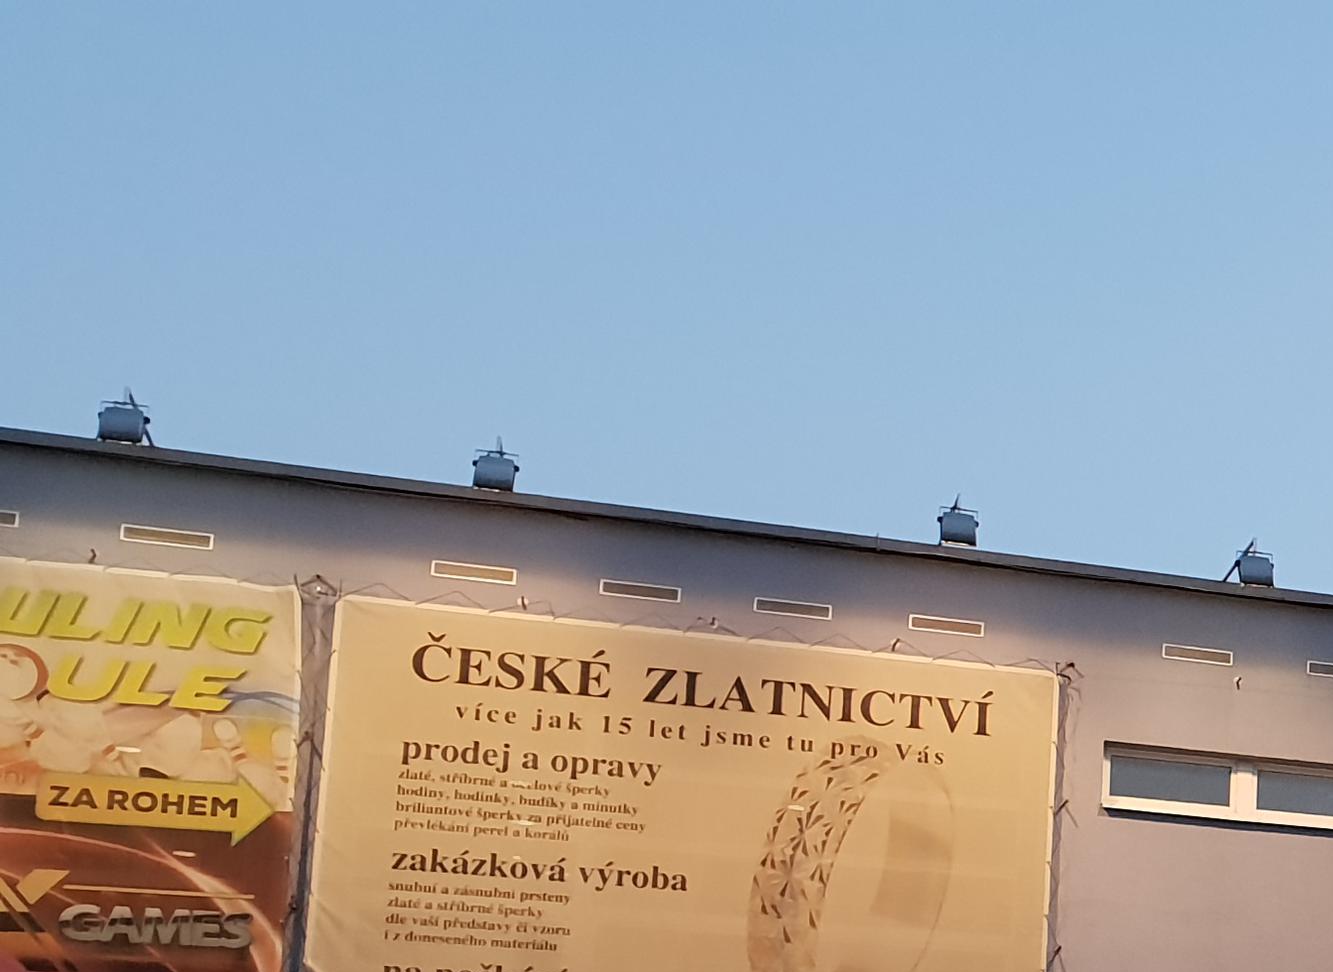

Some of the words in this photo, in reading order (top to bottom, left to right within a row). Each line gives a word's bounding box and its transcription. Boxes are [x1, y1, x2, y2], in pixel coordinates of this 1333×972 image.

[412, 631, 611, 699] ČESKÉ
[642, 667, 995, 737] ZLATNICTVÍ
[455, 702, 517, 725] více
[531, 708, 583, 732] jak
[603, 716, 632, 736] 15
[649, 719, 687, 741] let
[700, 725, 771, 751] jsme
[787, 734, 815, 754] tu
[831, 741, 879, 761] pro
[895, 743, 945, 765] Vás
[401, 739, 511, 773] prodej
[522, 752, 539, 771] a
[551, 753, 663, 787] opravy
[48, 785, 97, 809] ZA
[106, 788, 239, 818] ROHEM
[500, 780, 508, 788] a
[566, 783, 611, 798] šperky
[571, 802, 579, 810] a
[582, 801, 639, 817] minutky
[615, 822, 646, 834] ceny
[391, 848, 566, 883] zakázková
[578, 861, 688, 891] výroba
[424, 902, 433, 910] a
[440, 887, 449, 895] a
[519, 890, 571, 905] prsteny
[59, 904, 253, 949] GAMES
[385, 913, 406, 925] dle
